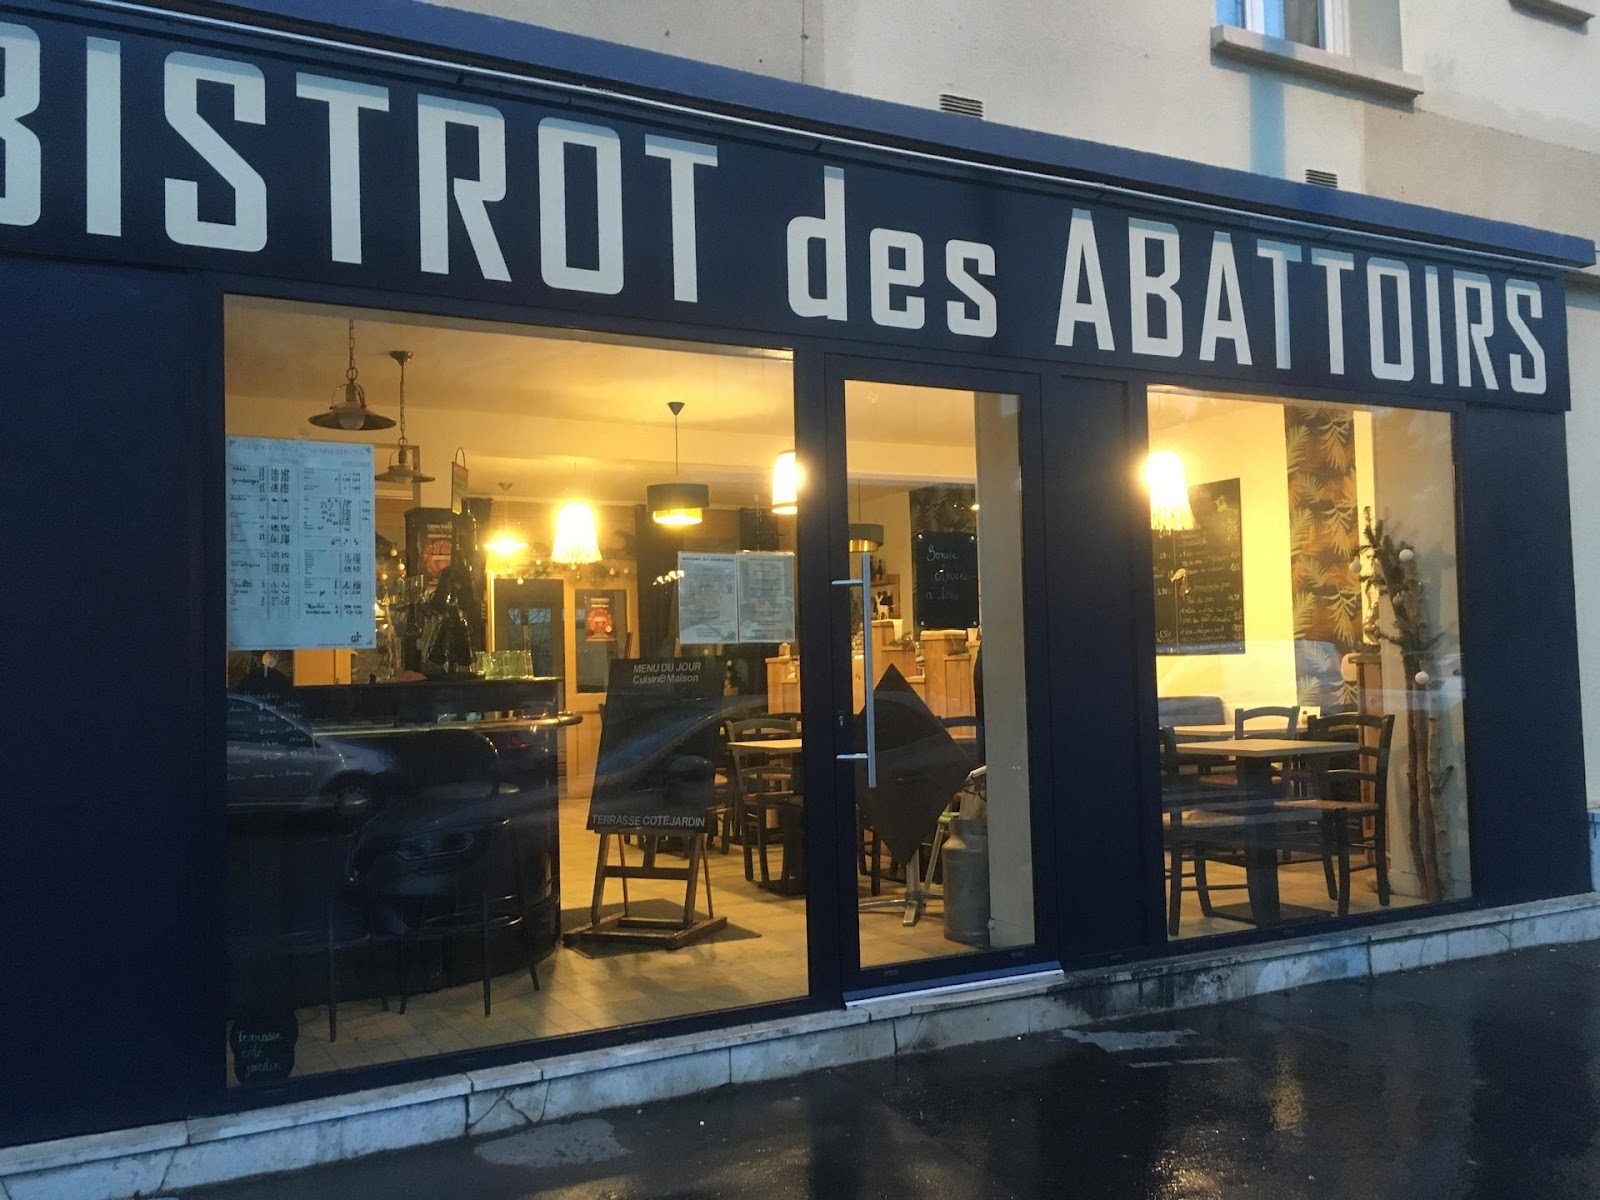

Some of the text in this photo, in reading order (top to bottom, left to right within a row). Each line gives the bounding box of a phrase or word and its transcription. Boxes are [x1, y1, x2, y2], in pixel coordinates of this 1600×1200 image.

[787, 165, 998, 338] des
[1056, 208, 1548, 396] ABATTOIRS
[633, 661, 702, 673] MENU DU JOUR
[592, 814, 641, 826] TERRASSE
